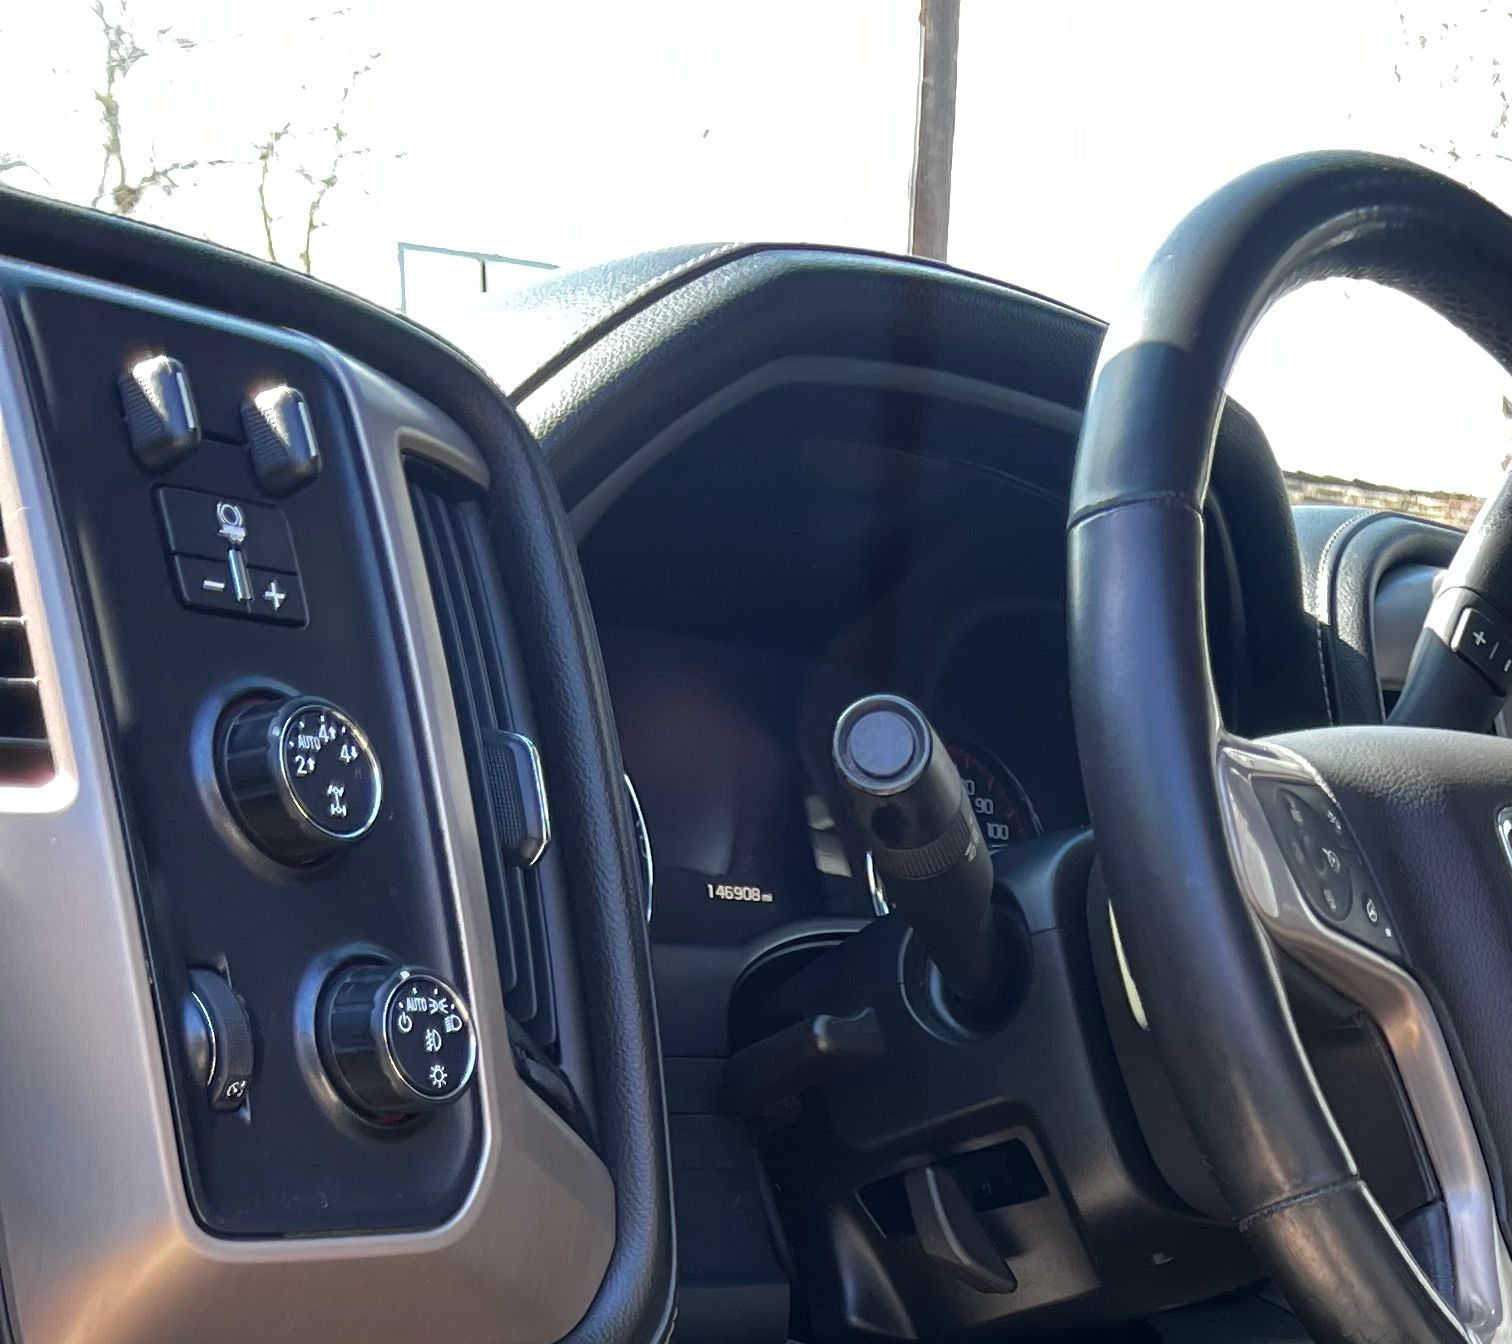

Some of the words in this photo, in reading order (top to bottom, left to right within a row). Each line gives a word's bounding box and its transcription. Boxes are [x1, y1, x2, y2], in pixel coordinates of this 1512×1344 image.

[297, 734, 321, 752] AUTO
[974, 798, 994, 815] 90
[985, 821, 1009, 841] 100
[707, 883, 761, 902] 146908
[406, 997, 428, 1012] AUTO
